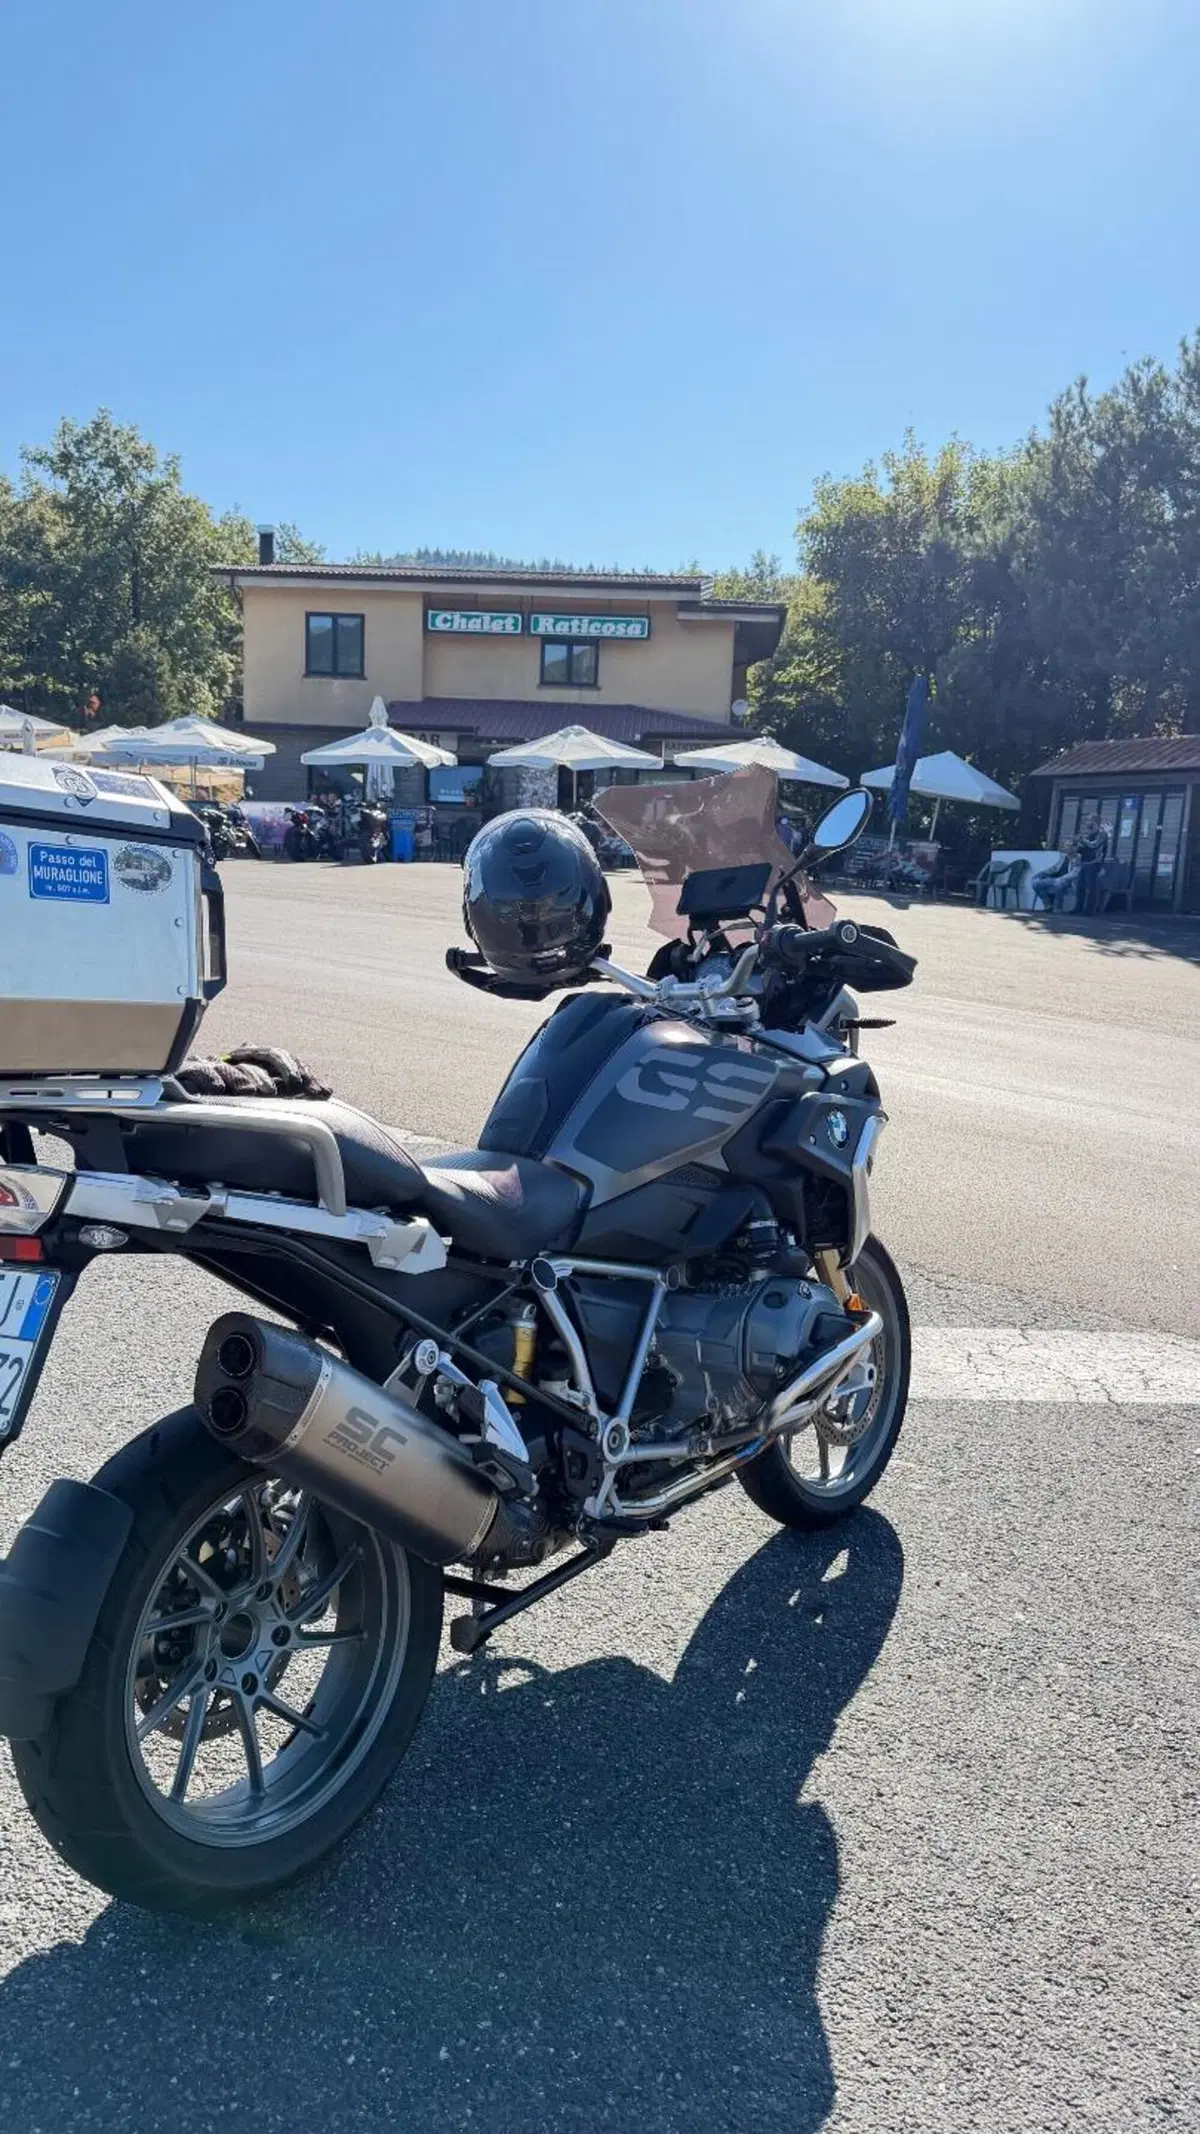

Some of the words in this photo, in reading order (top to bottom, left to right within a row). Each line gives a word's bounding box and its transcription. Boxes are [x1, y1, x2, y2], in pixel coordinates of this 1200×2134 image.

[435, 613, 515, 631] Chalet
[538, 617, 643, 636] Raticosa
[405, 732, 440, 748] AR
[40, 851, 75, 865] Passo
[79, 855, 97, 868] del
[33, 865, 104, 885] MURAGLIONE
[616, 1047, 778, 1125] GS
[335, 1406, 408, 1463] SC
[326, 1431, 390, 1471] PROJECT
